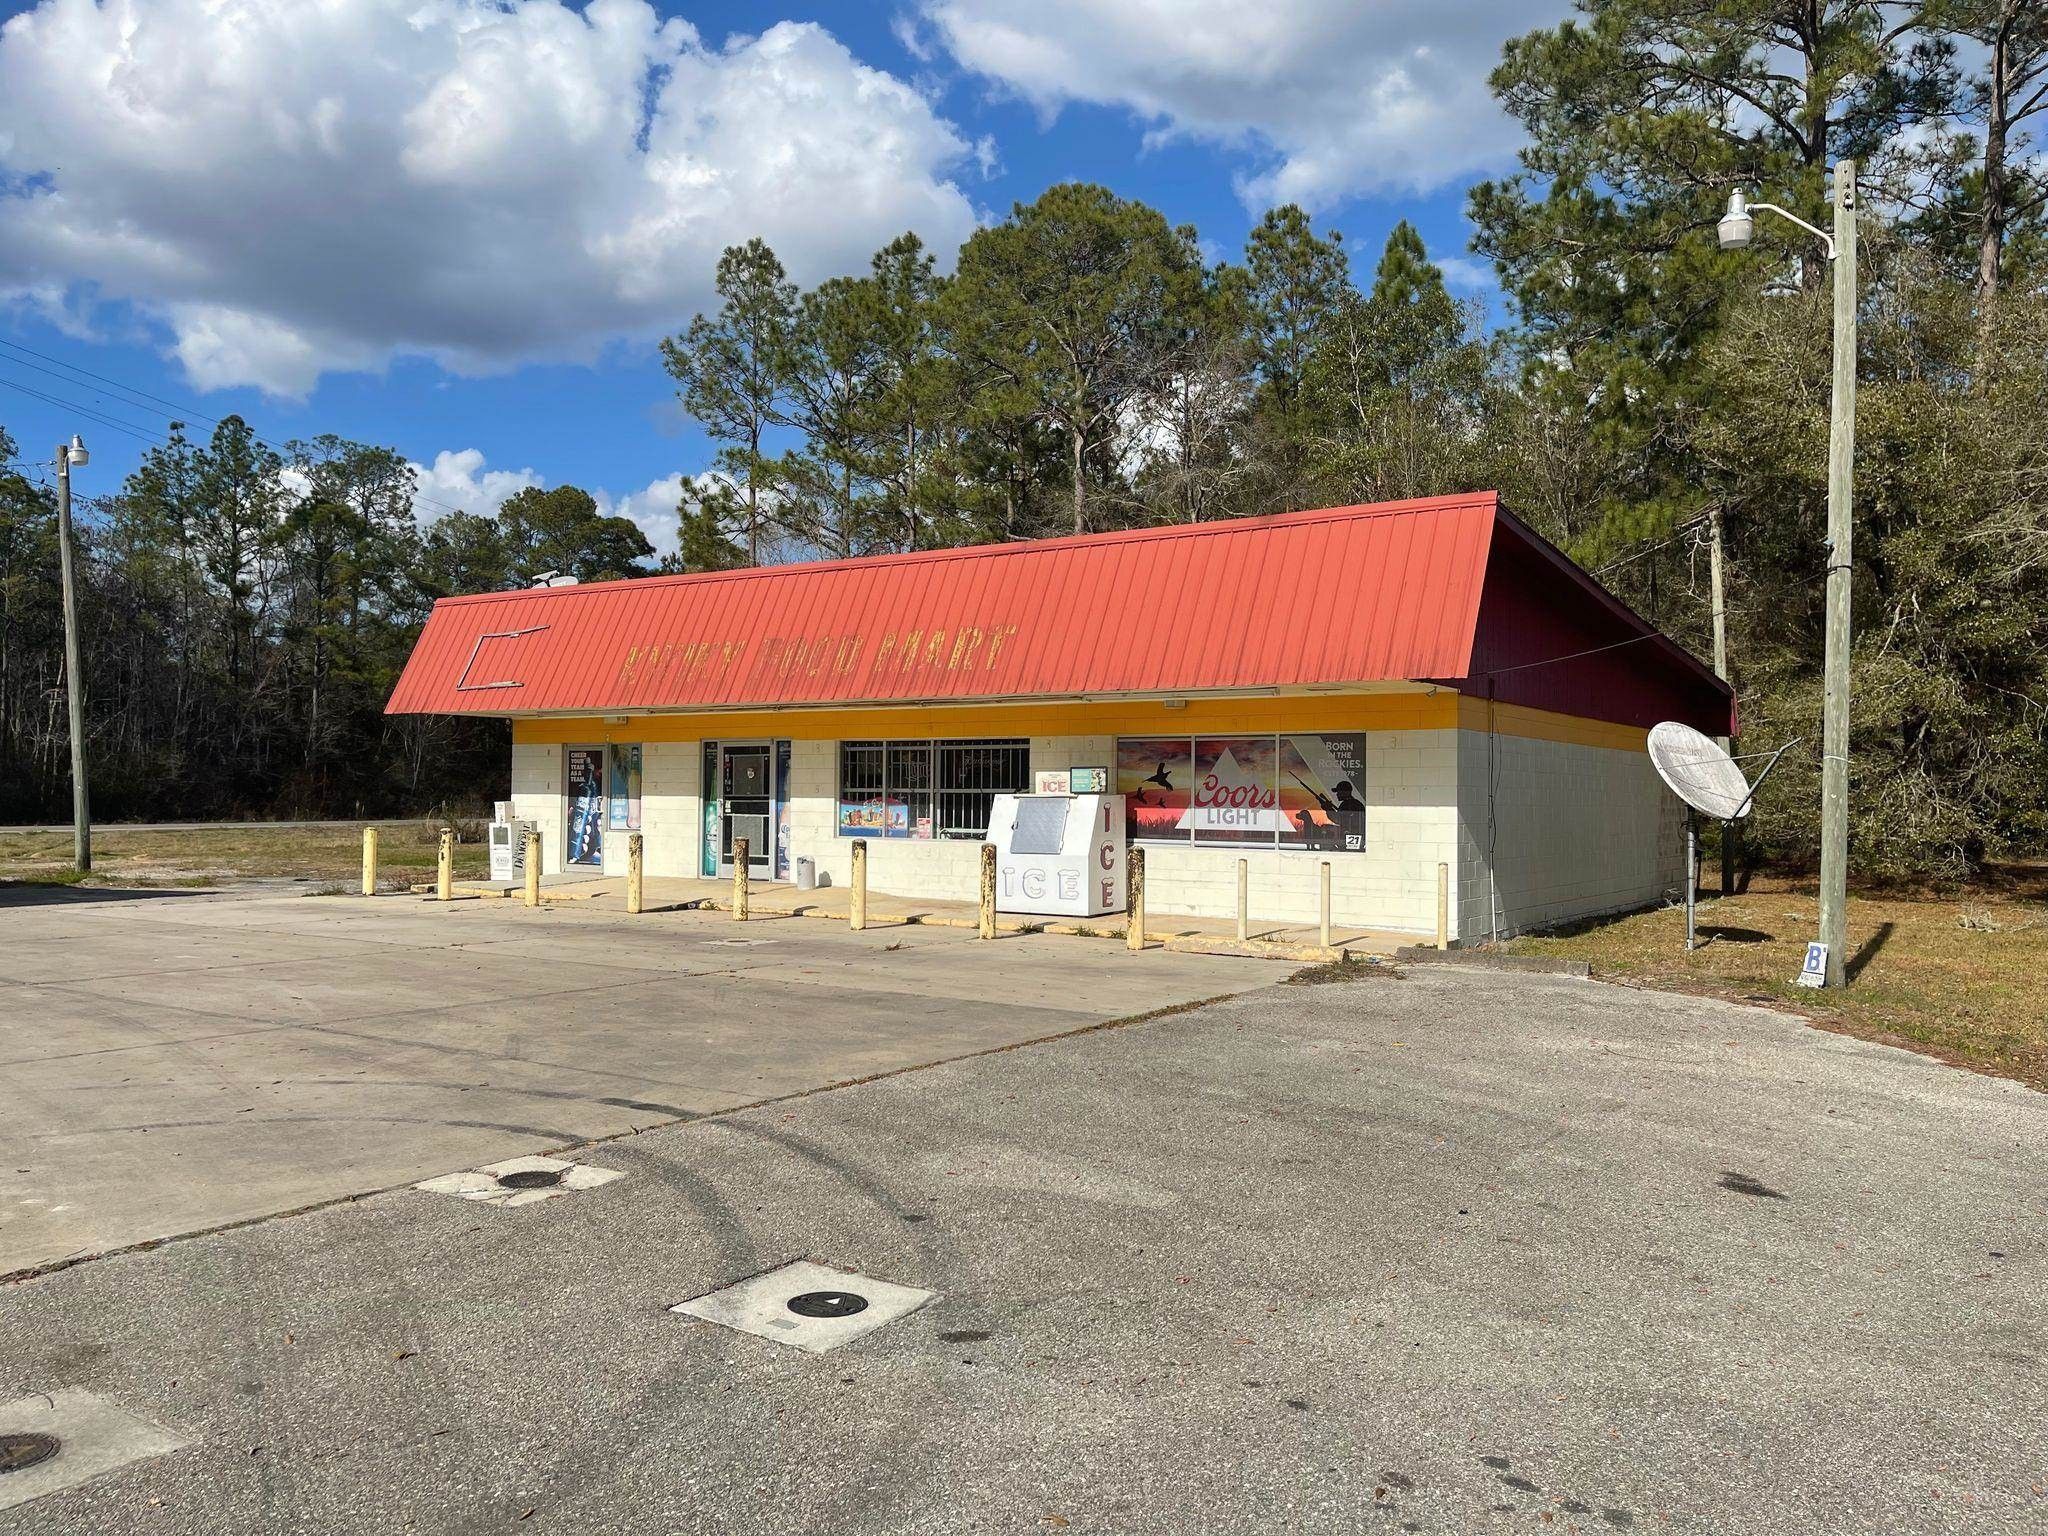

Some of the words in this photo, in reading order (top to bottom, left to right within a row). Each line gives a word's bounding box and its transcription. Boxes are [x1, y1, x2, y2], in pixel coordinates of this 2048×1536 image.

[875, 624, 1017, 674] MART
[1326, 742, 1354, 751] BORN
[1041, 780, 1066, 792] ICE
[1195, 774, 1276, 808] Coors
[1207, 809, 1260, 825] LIGHT
[1347, 836, 1360, 845] 21
[1100, 802, 1115, 908] ICE
[1003, 866, 1081, 900] ICE
